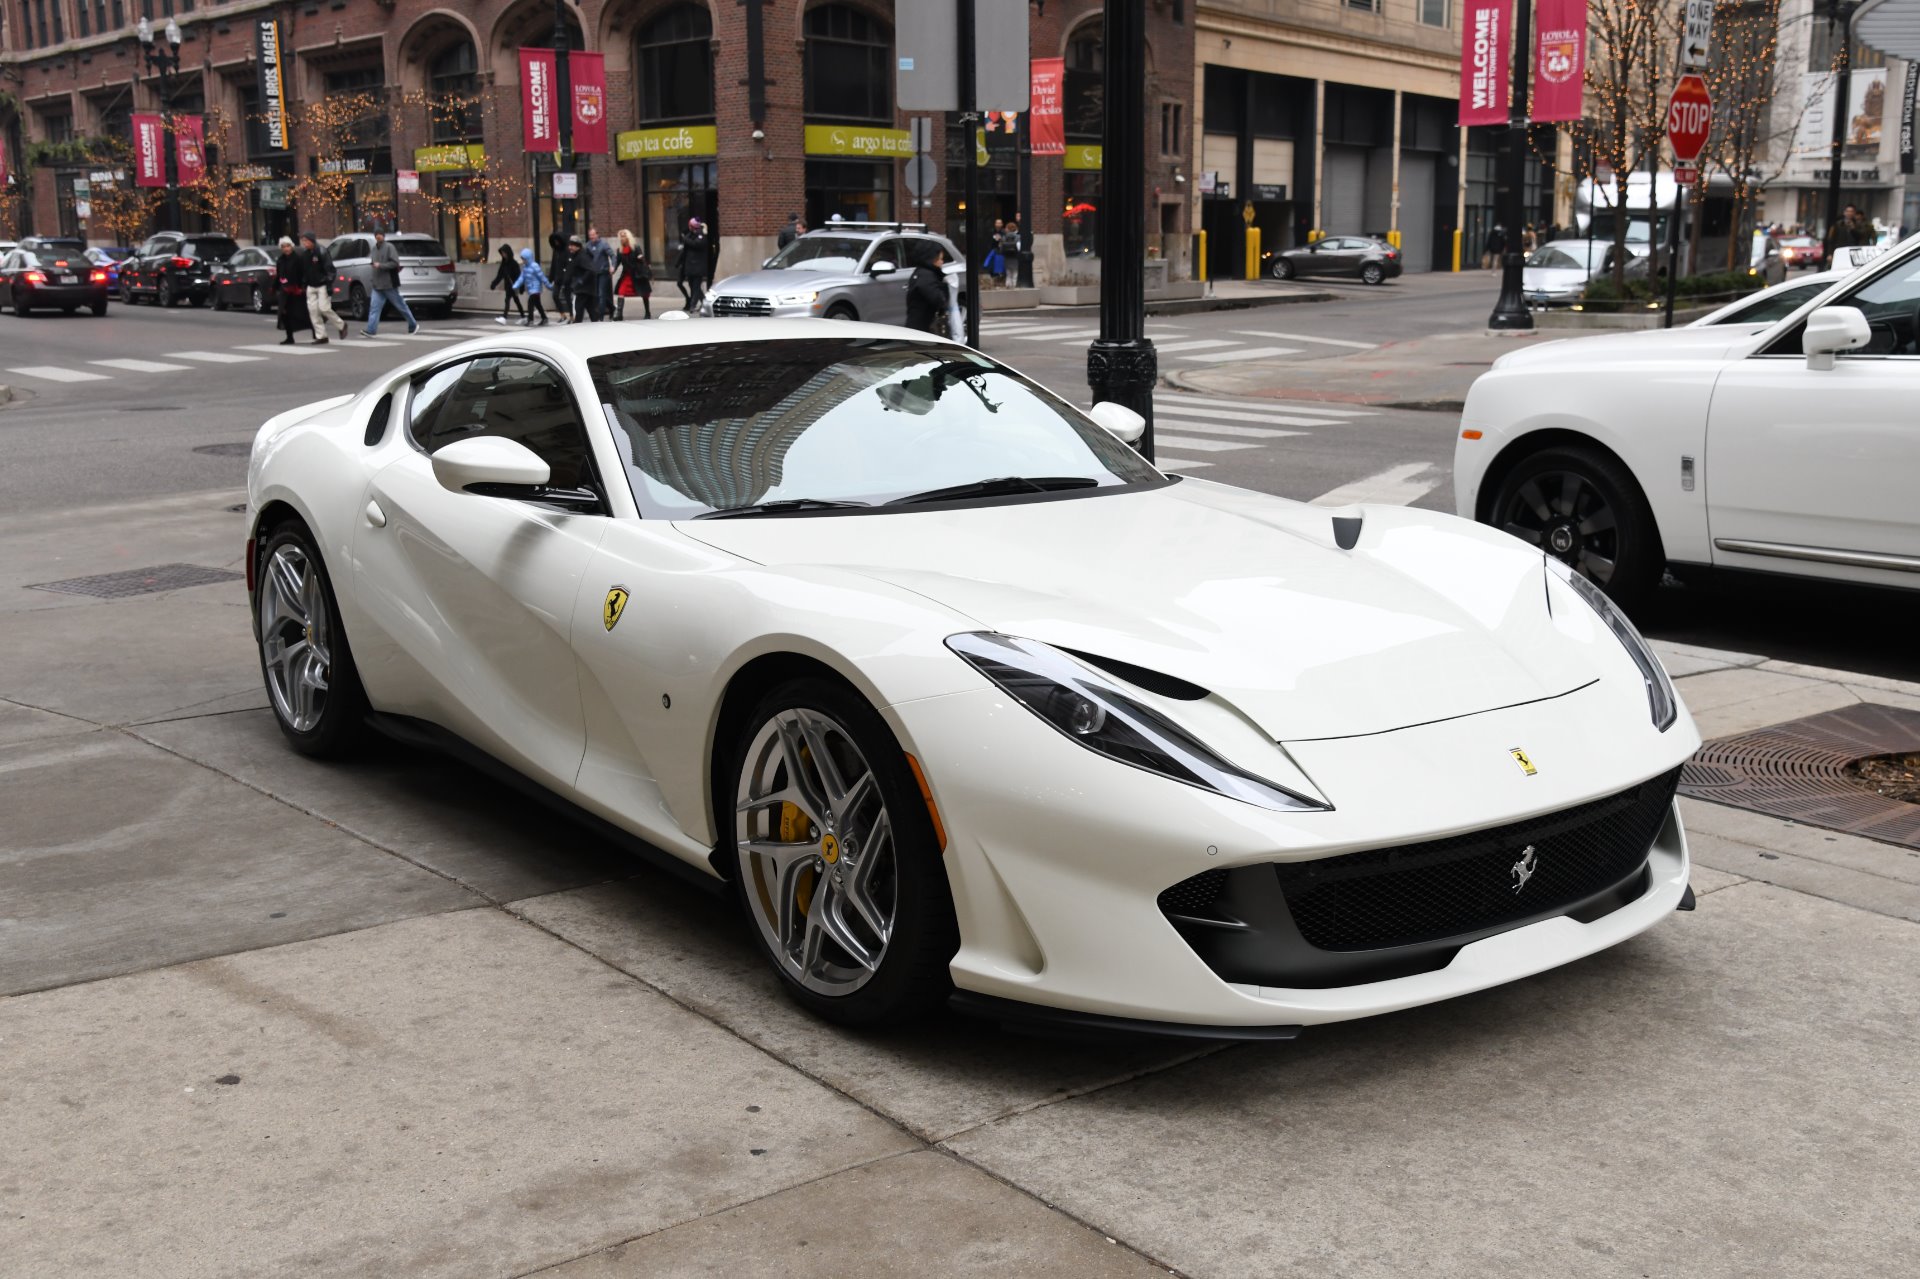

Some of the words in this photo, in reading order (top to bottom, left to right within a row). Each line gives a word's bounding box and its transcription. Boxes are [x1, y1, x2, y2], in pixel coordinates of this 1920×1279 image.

[1689, 2, 1710, 21] ONE
[1489, 8, 1500, 46] CAMPUS
[1541, 30, 1580, 41] LOYOLA
[1688, 22, 1708, 39] WAY
[261, 21, 276, 64] BAGELS
[1472, 8, 1490, 109] WELCOME
[1489, 46, 1498, 78] TOWER
[529, 60, 544, 139] WELCOME
[575, 85, 602, 93] LOYOLA
[1032, 84, 1056, 96] David
[1488, 80, 1496, 109] WATER
[1670, 101, 1709, 135] STOP
[140, 123, 154, 178] WELCOME
[644, 136, 660, 152] tea
[662, 128, 694, 150] café
[852, 136, 881, 154] argo
[882, 136, 897, 151] tea
